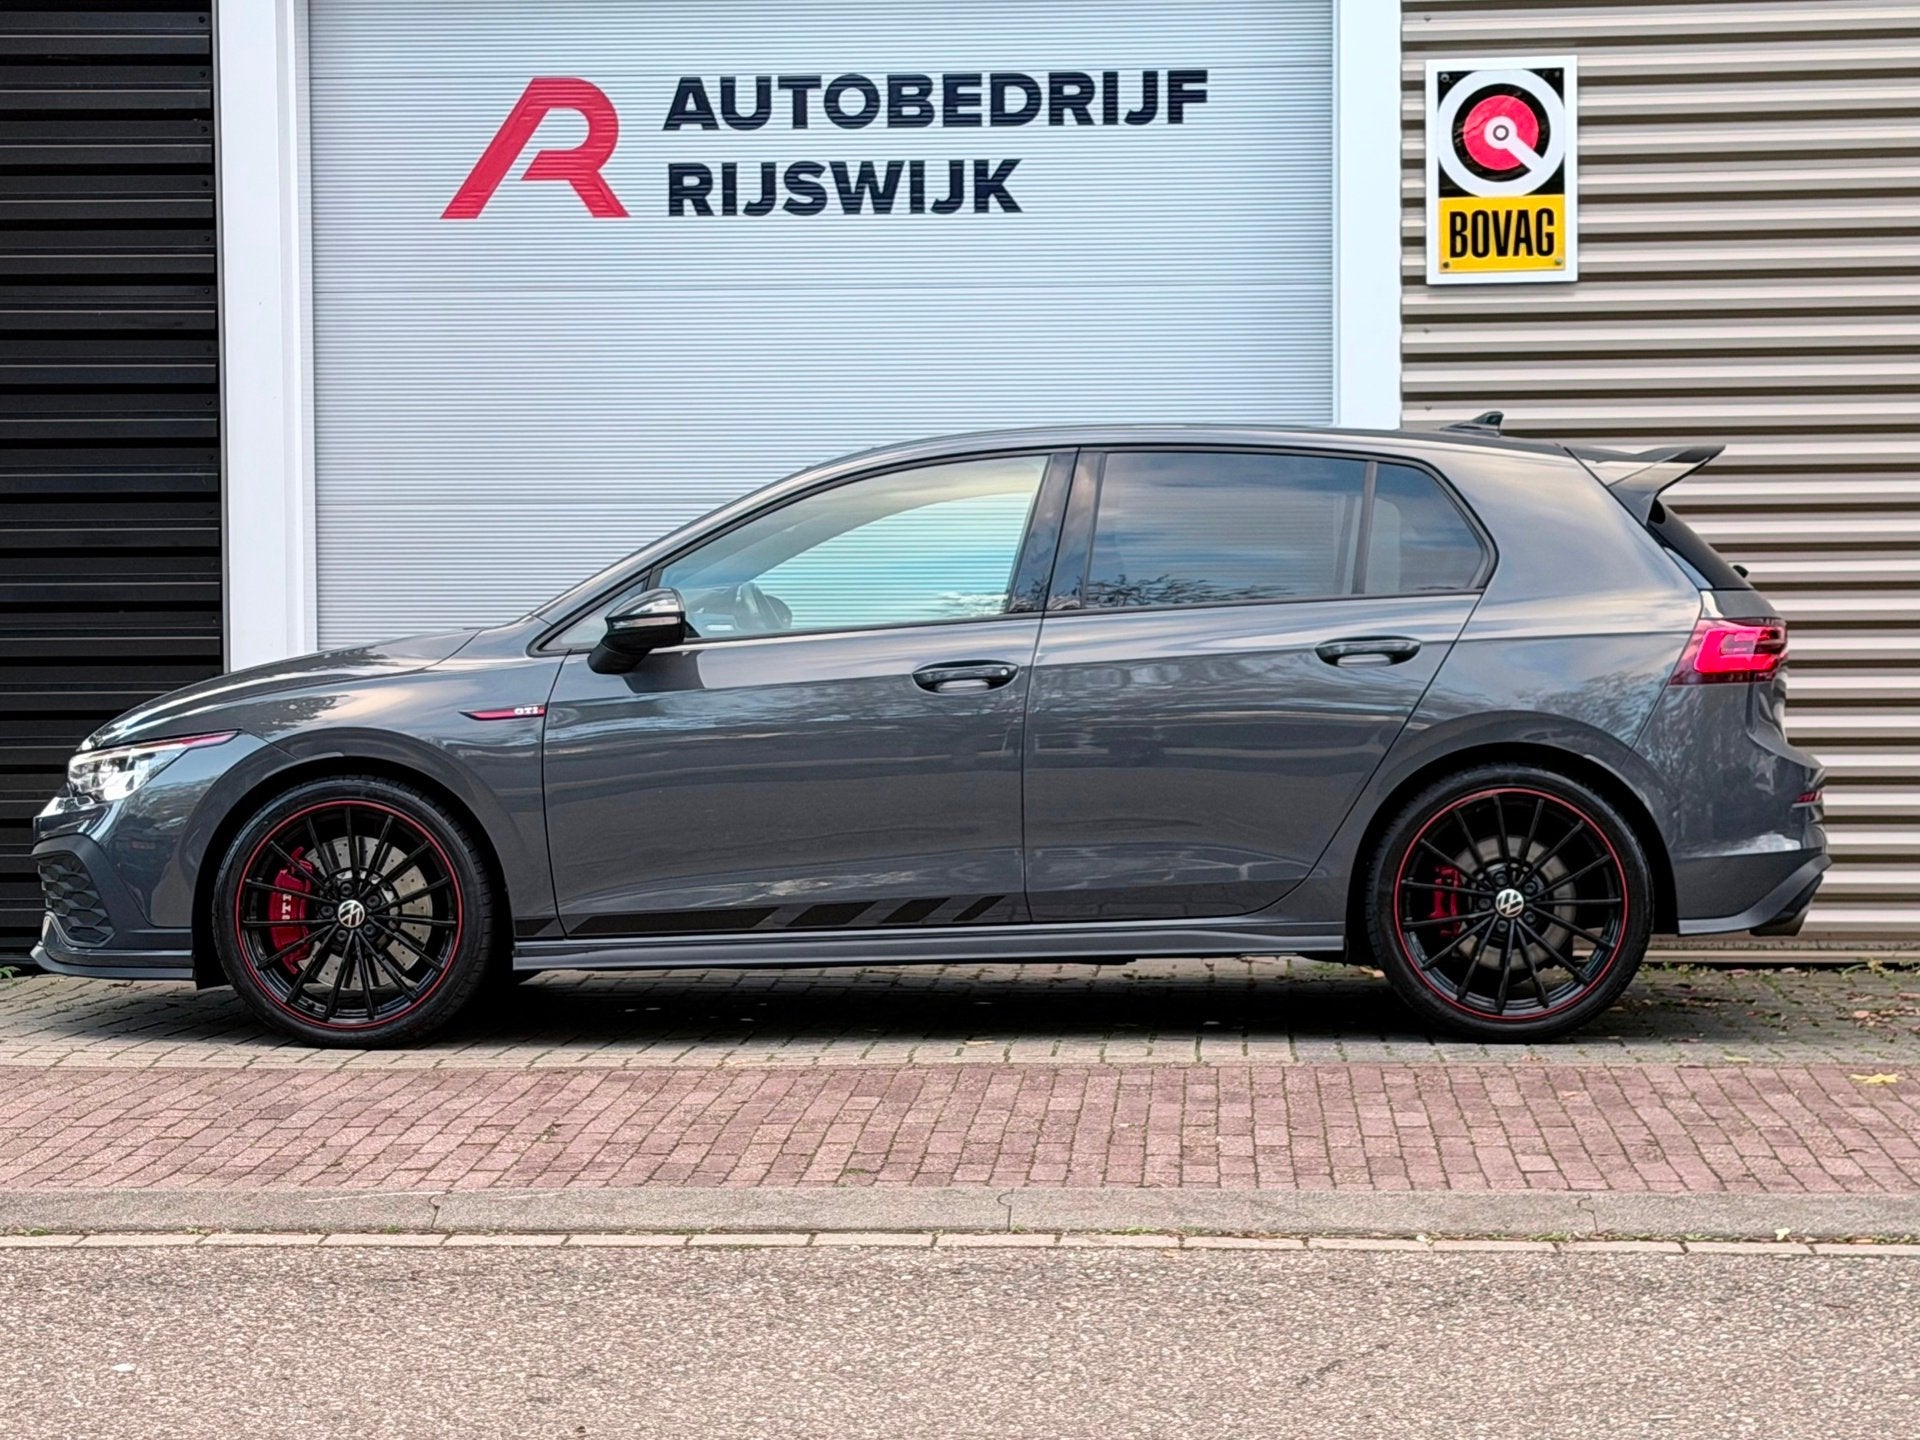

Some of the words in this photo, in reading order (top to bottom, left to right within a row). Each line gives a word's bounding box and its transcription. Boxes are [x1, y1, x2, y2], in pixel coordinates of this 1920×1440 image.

[663, 69, 1208, 131] AUTOBEDRIJF
[668, 158, 1024, 217] RIJSWIJK
[1449, 207, 1555, 258] BOVAG
